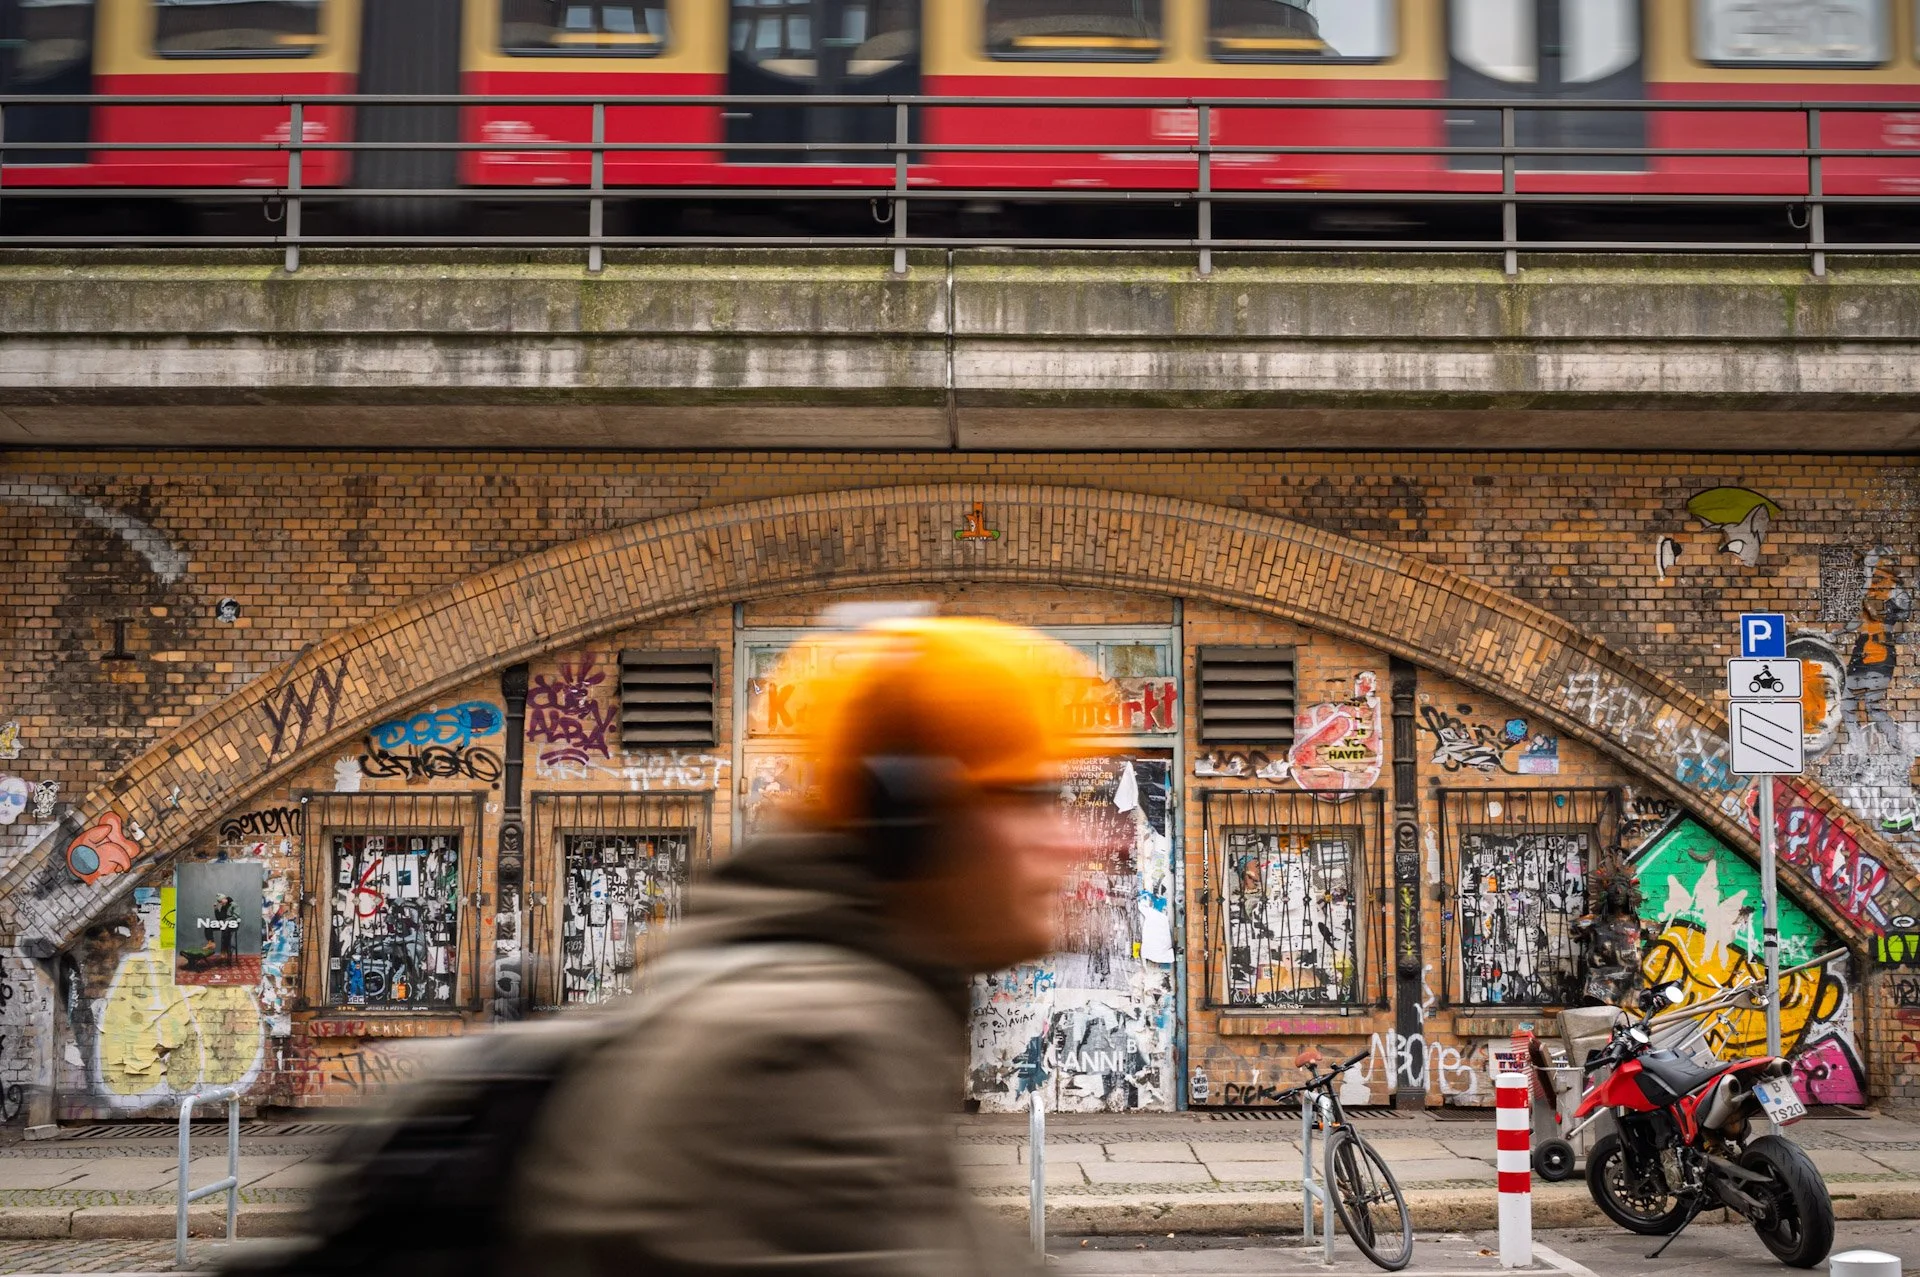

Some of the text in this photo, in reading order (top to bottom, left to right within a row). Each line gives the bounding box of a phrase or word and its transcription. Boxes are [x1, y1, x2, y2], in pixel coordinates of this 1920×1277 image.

[1749, 620, 1772, 652] P
[1329, 750, 1365, 760] HAVE?
[1771, 1082, 1781, 1093] B
